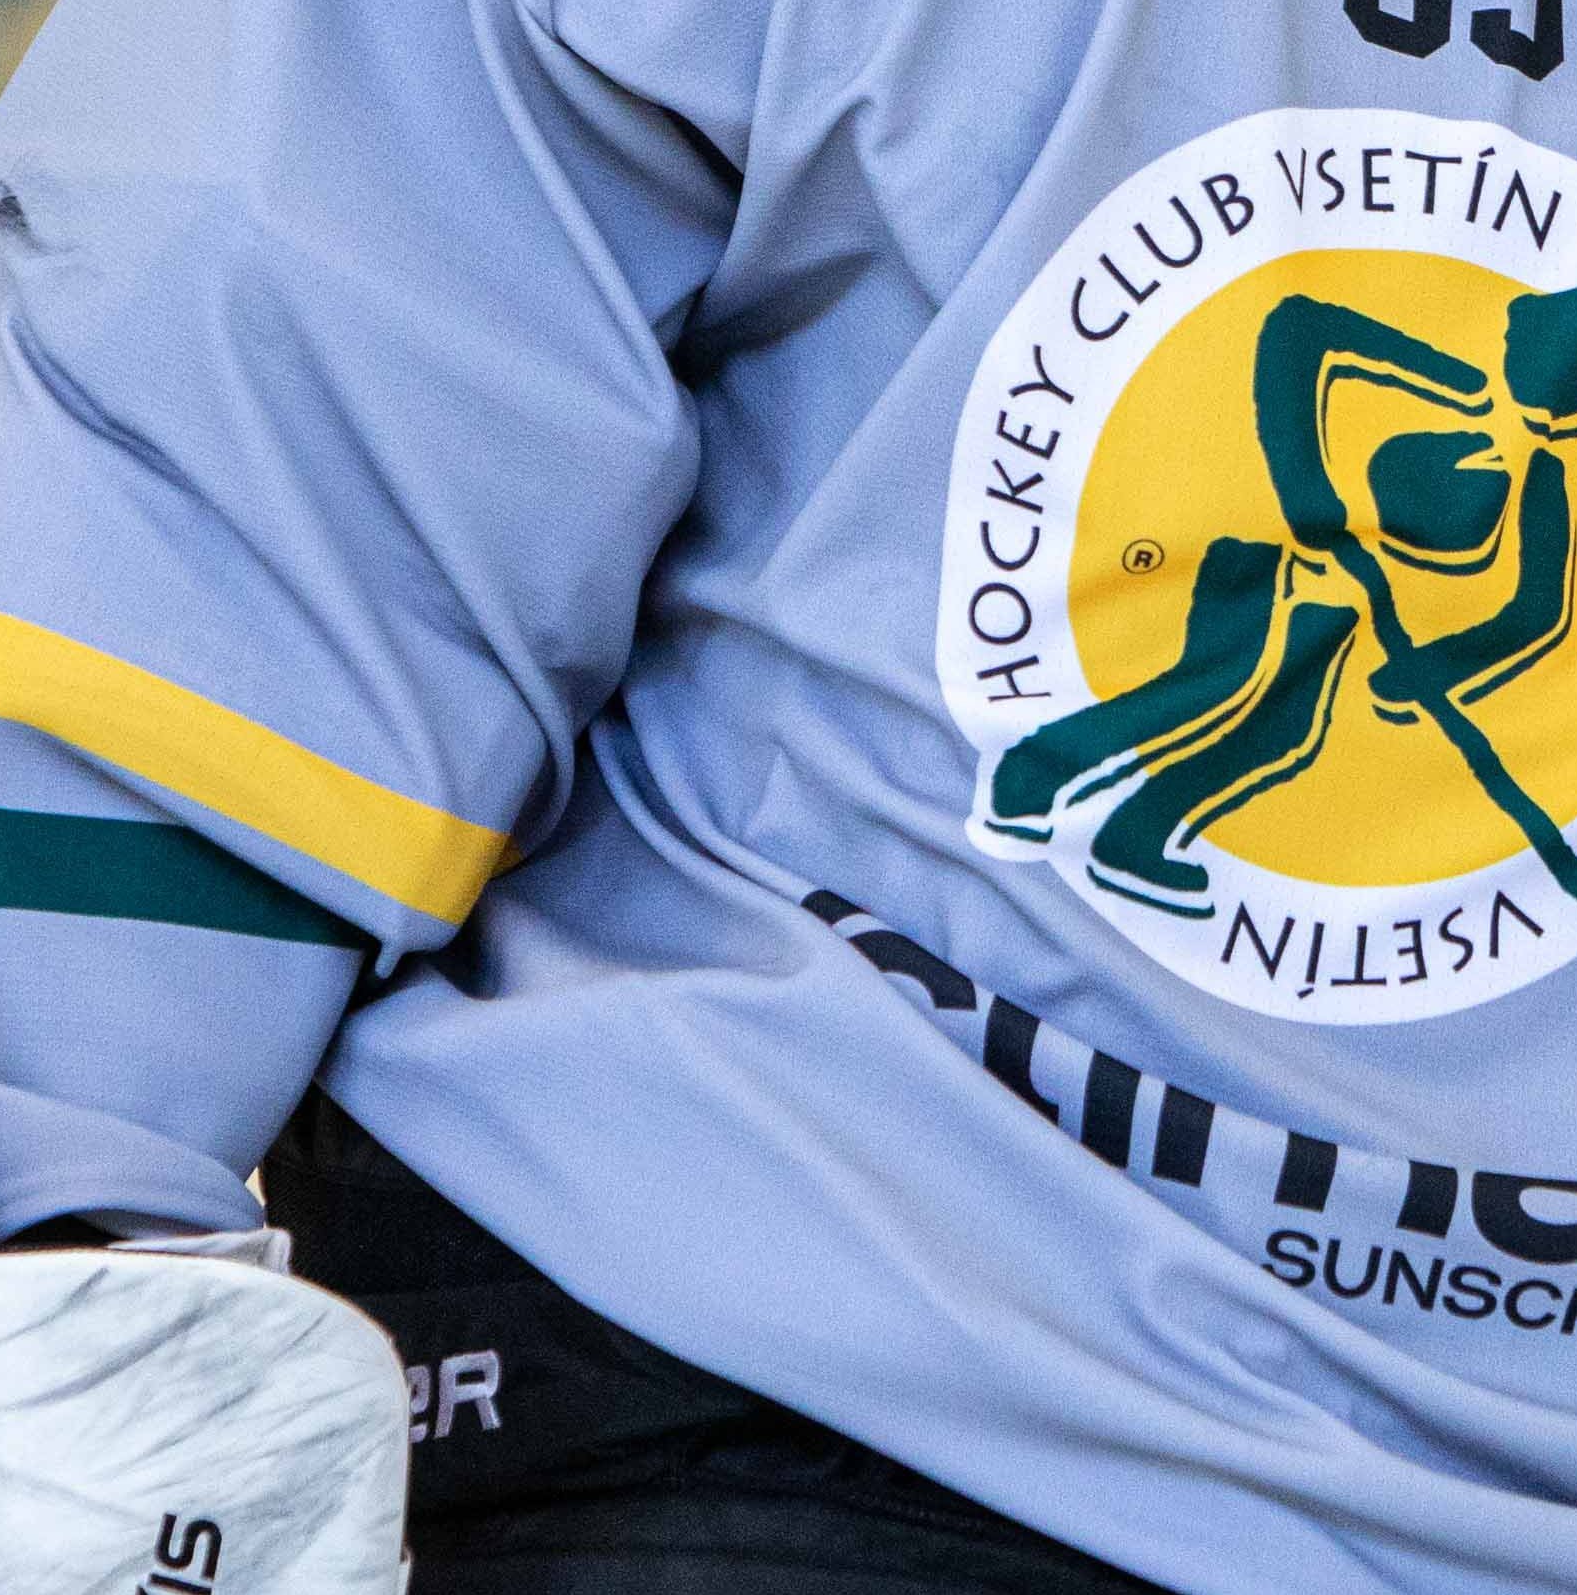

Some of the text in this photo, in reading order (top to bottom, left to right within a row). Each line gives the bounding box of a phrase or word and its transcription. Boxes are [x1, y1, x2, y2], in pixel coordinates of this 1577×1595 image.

[967, 146, 1563, 703] HOCKEY CLUB VSETÍN
[1219, 889, 1545, 1000] VSETÍN
